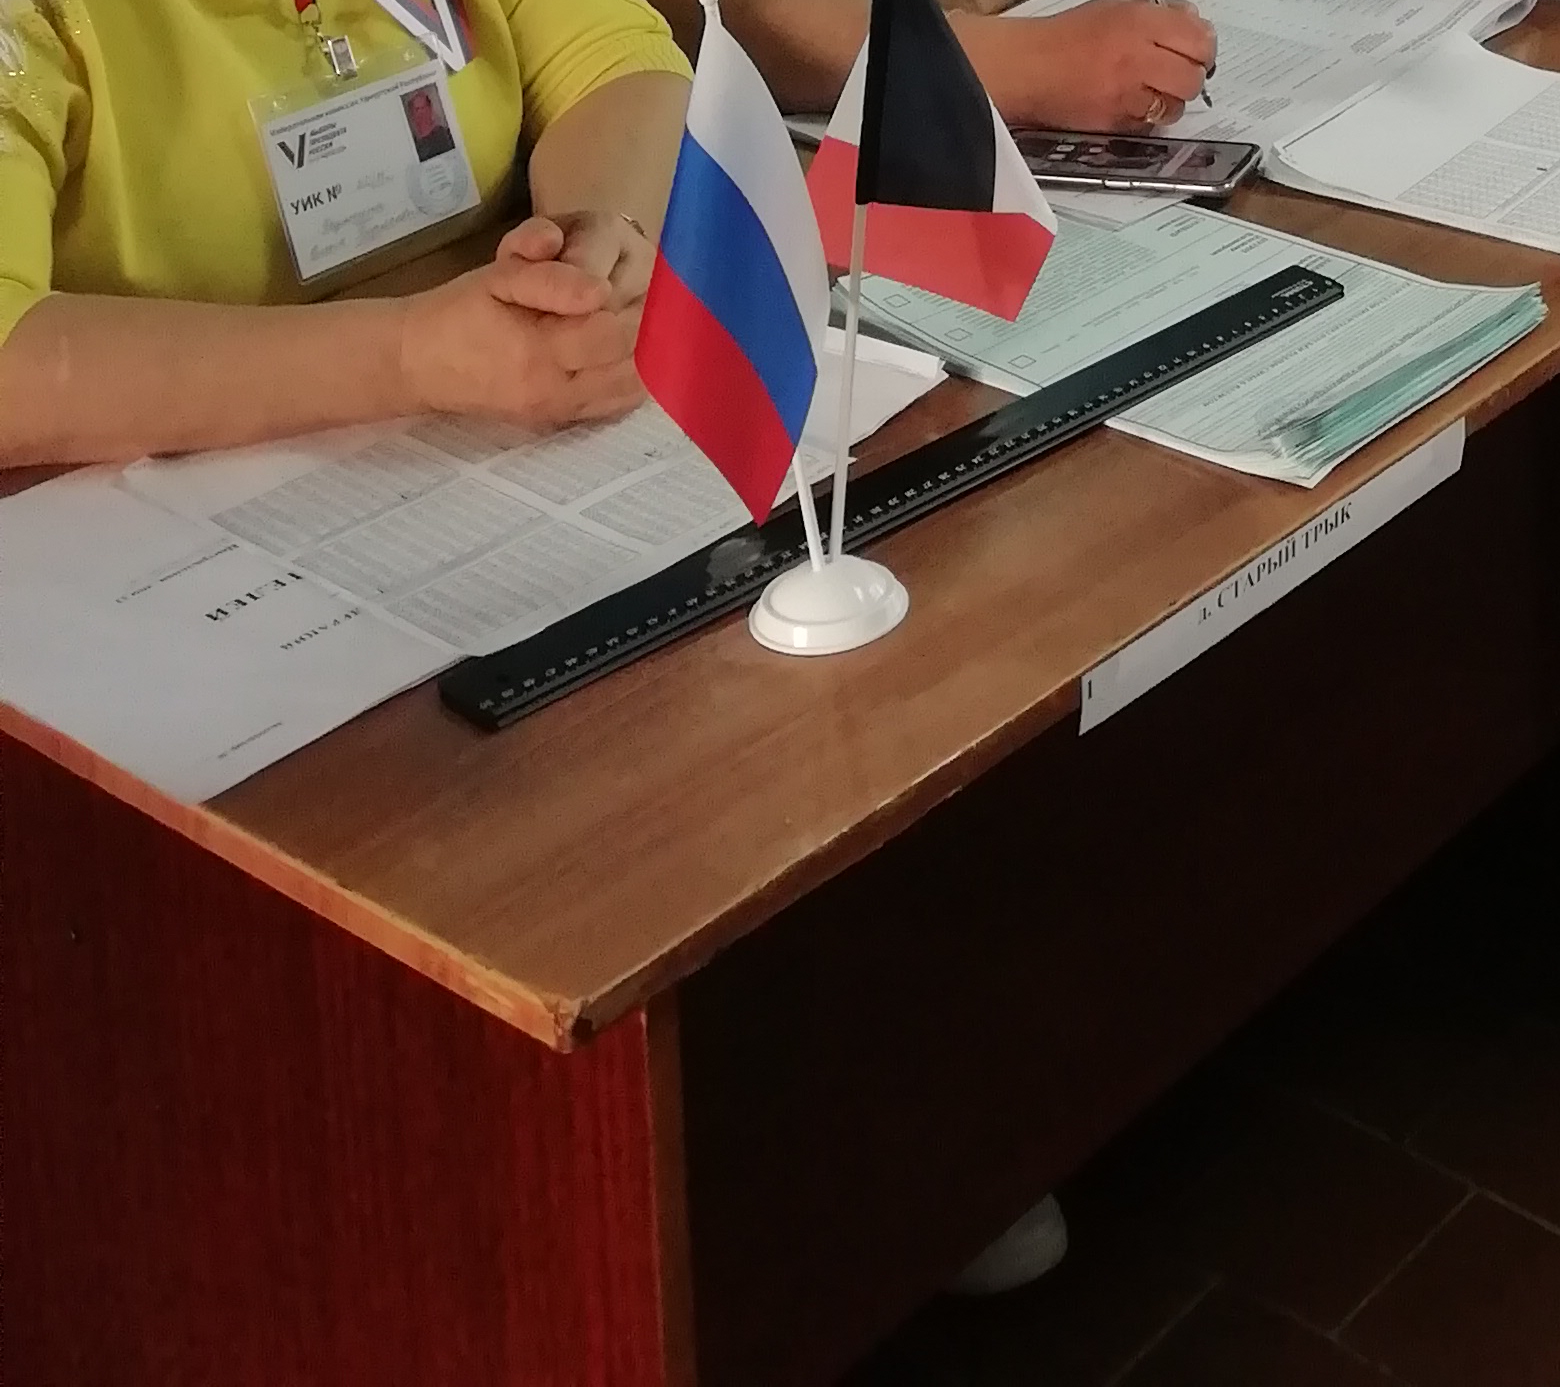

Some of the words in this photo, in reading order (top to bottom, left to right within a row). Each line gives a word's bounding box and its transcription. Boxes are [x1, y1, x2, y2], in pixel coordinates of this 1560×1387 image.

[290, 189, 324, 215] УИК
[1216, 537, 1298, 610] СТАРЫЙ
[1301, 501, 1354, 550] ТРЫК
